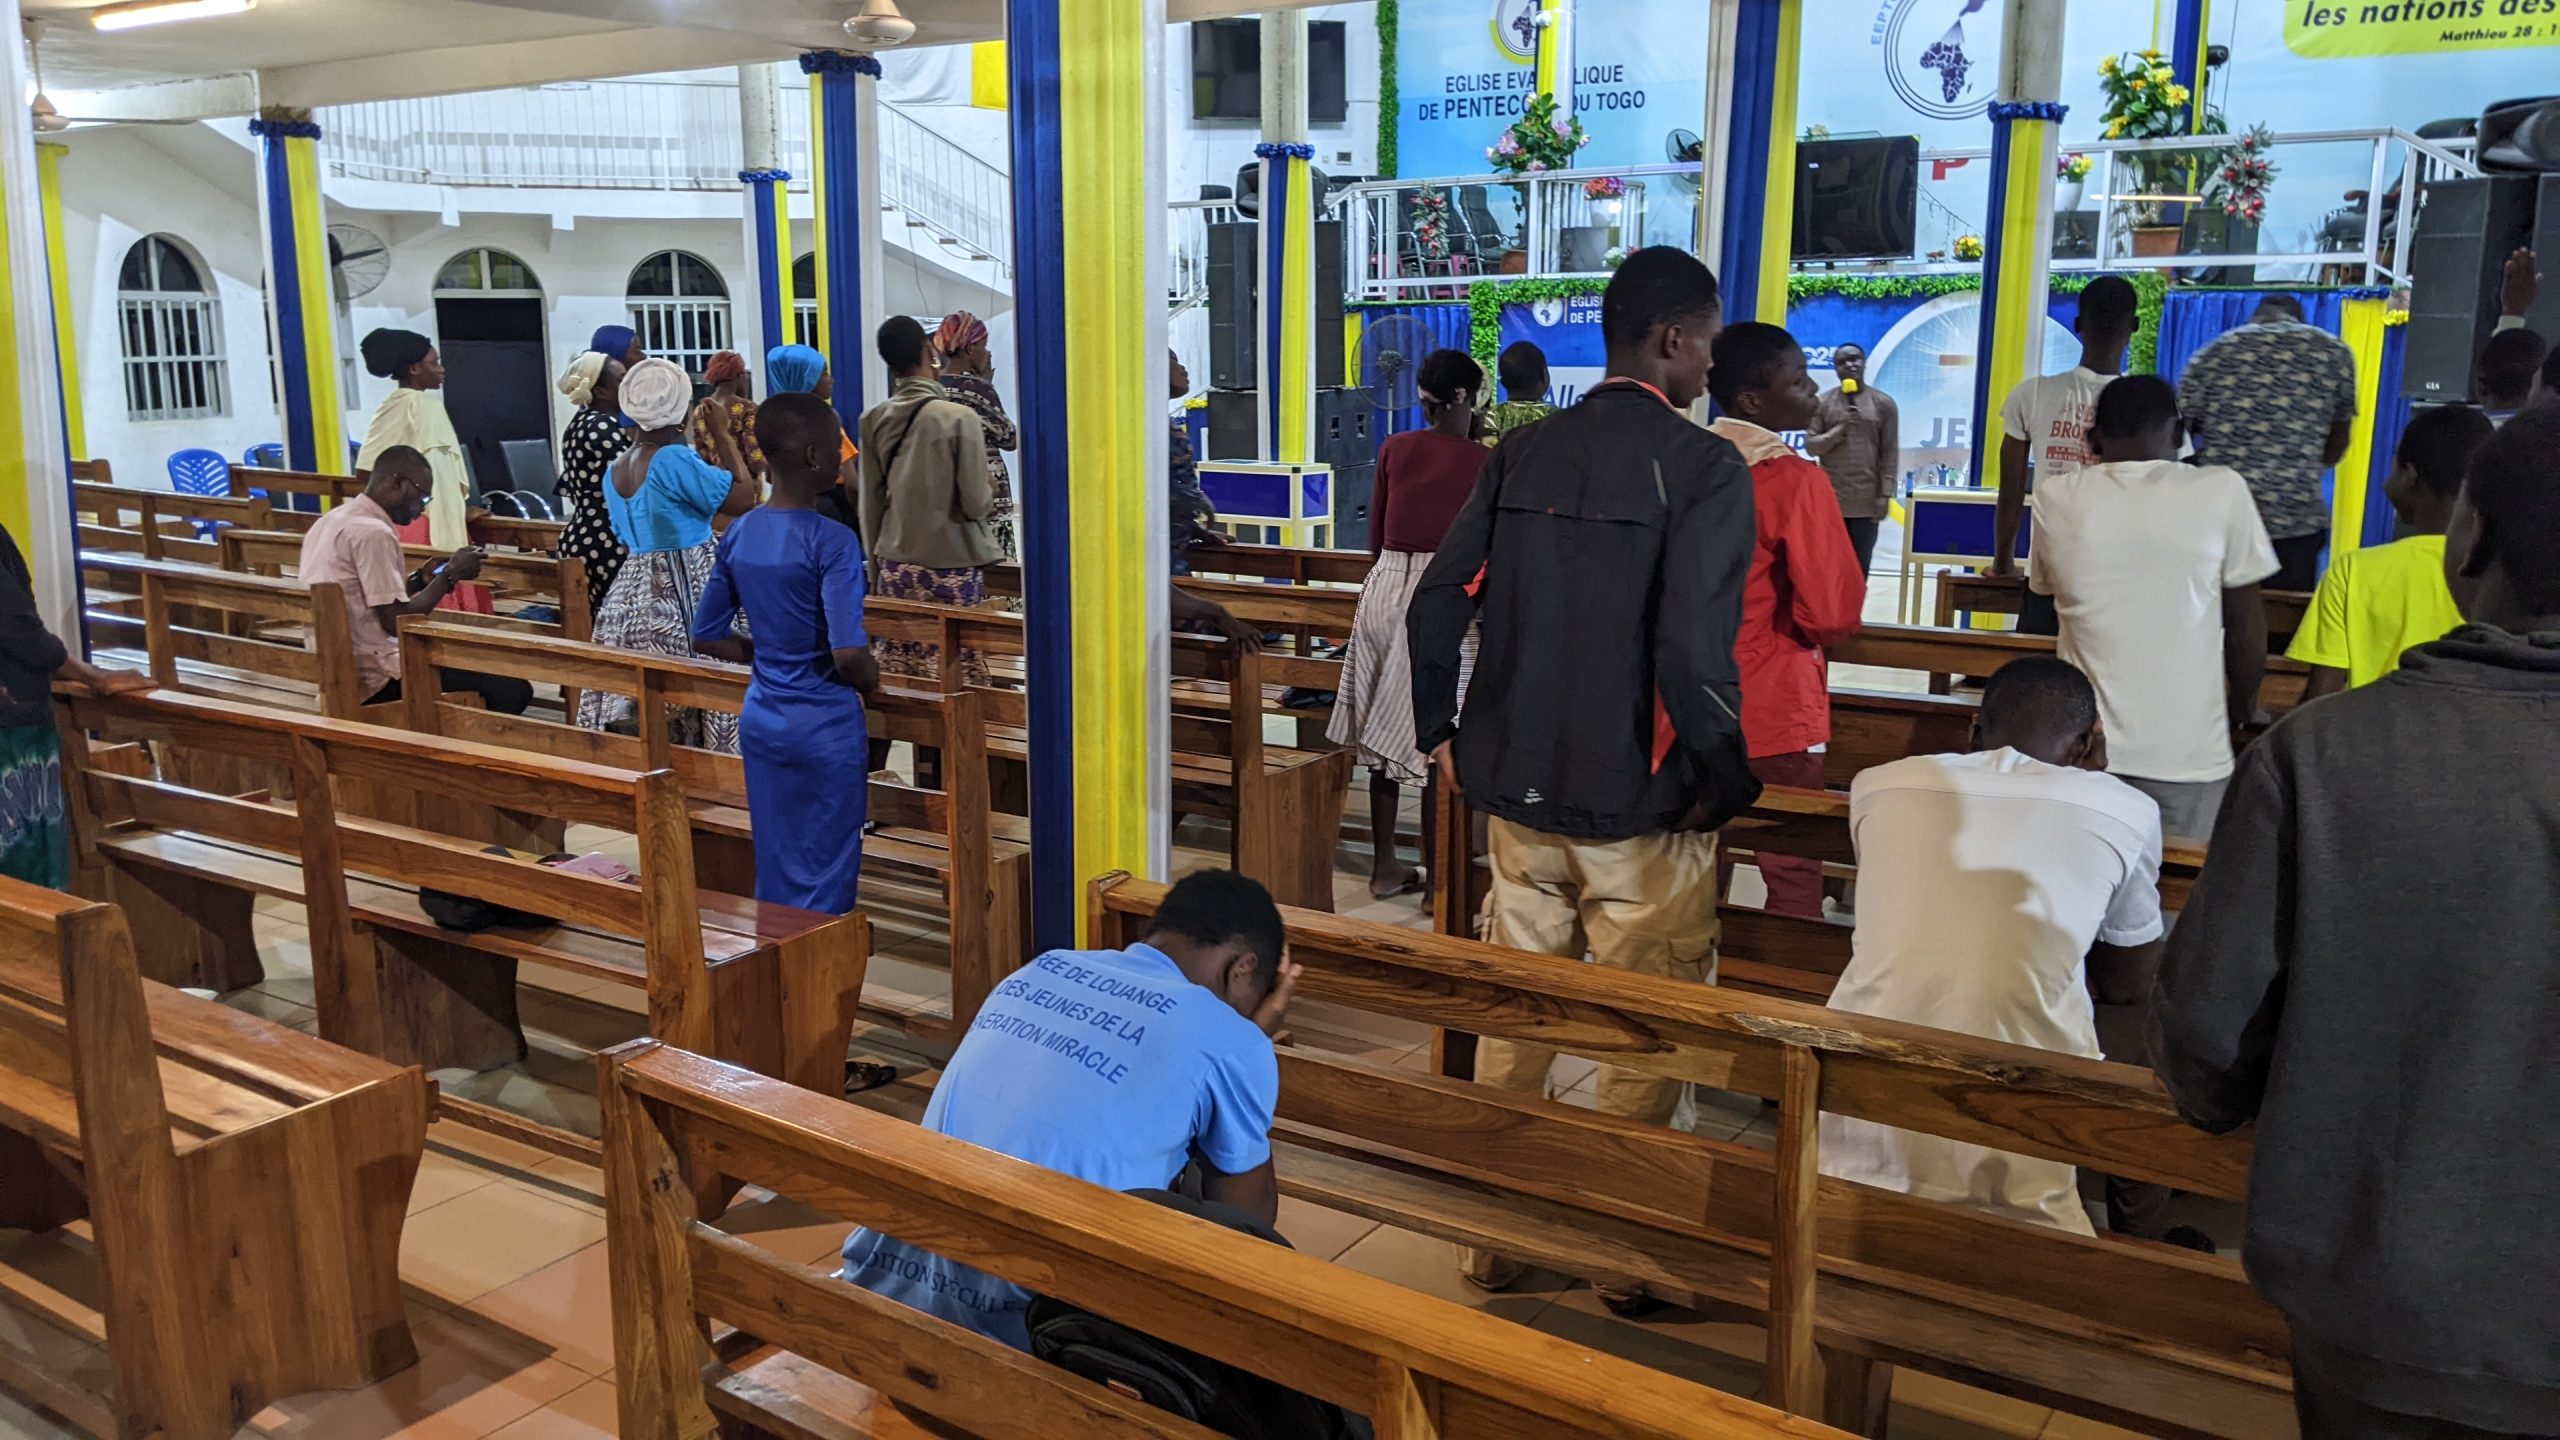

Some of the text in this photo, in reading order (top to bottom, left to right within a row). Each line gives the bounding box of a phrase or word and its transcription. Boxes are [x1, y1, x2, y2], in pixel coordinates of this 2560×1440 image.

[1871, 0, 1897, 45] EEPT
[2302, 3, 2347, 27] les
[2360, 0, 2484, 24] nations
[2439, 28, 2508, 42] Matthieu
[2512, 25, 2533, 38] 28
[1445, 65, 1624, 94] EGLISE EVALIQUE
[1419, 103, 1439, 121] DE
[1596, 90, 1646, 111] TOGO
[1570, 295, 1604, 308] EGLIS
[1570, 312, 1585, 324] DE
[1063, 965, 1094, 985] DE
[1088, 974, 1178, 1015] LOUANGE
[996, 979, 1146, 1046] DES JEUNES DE LA
[1042, 1031, 1129, 1085] MIRACLE
[858, 1251, 933, 1285] DITION
